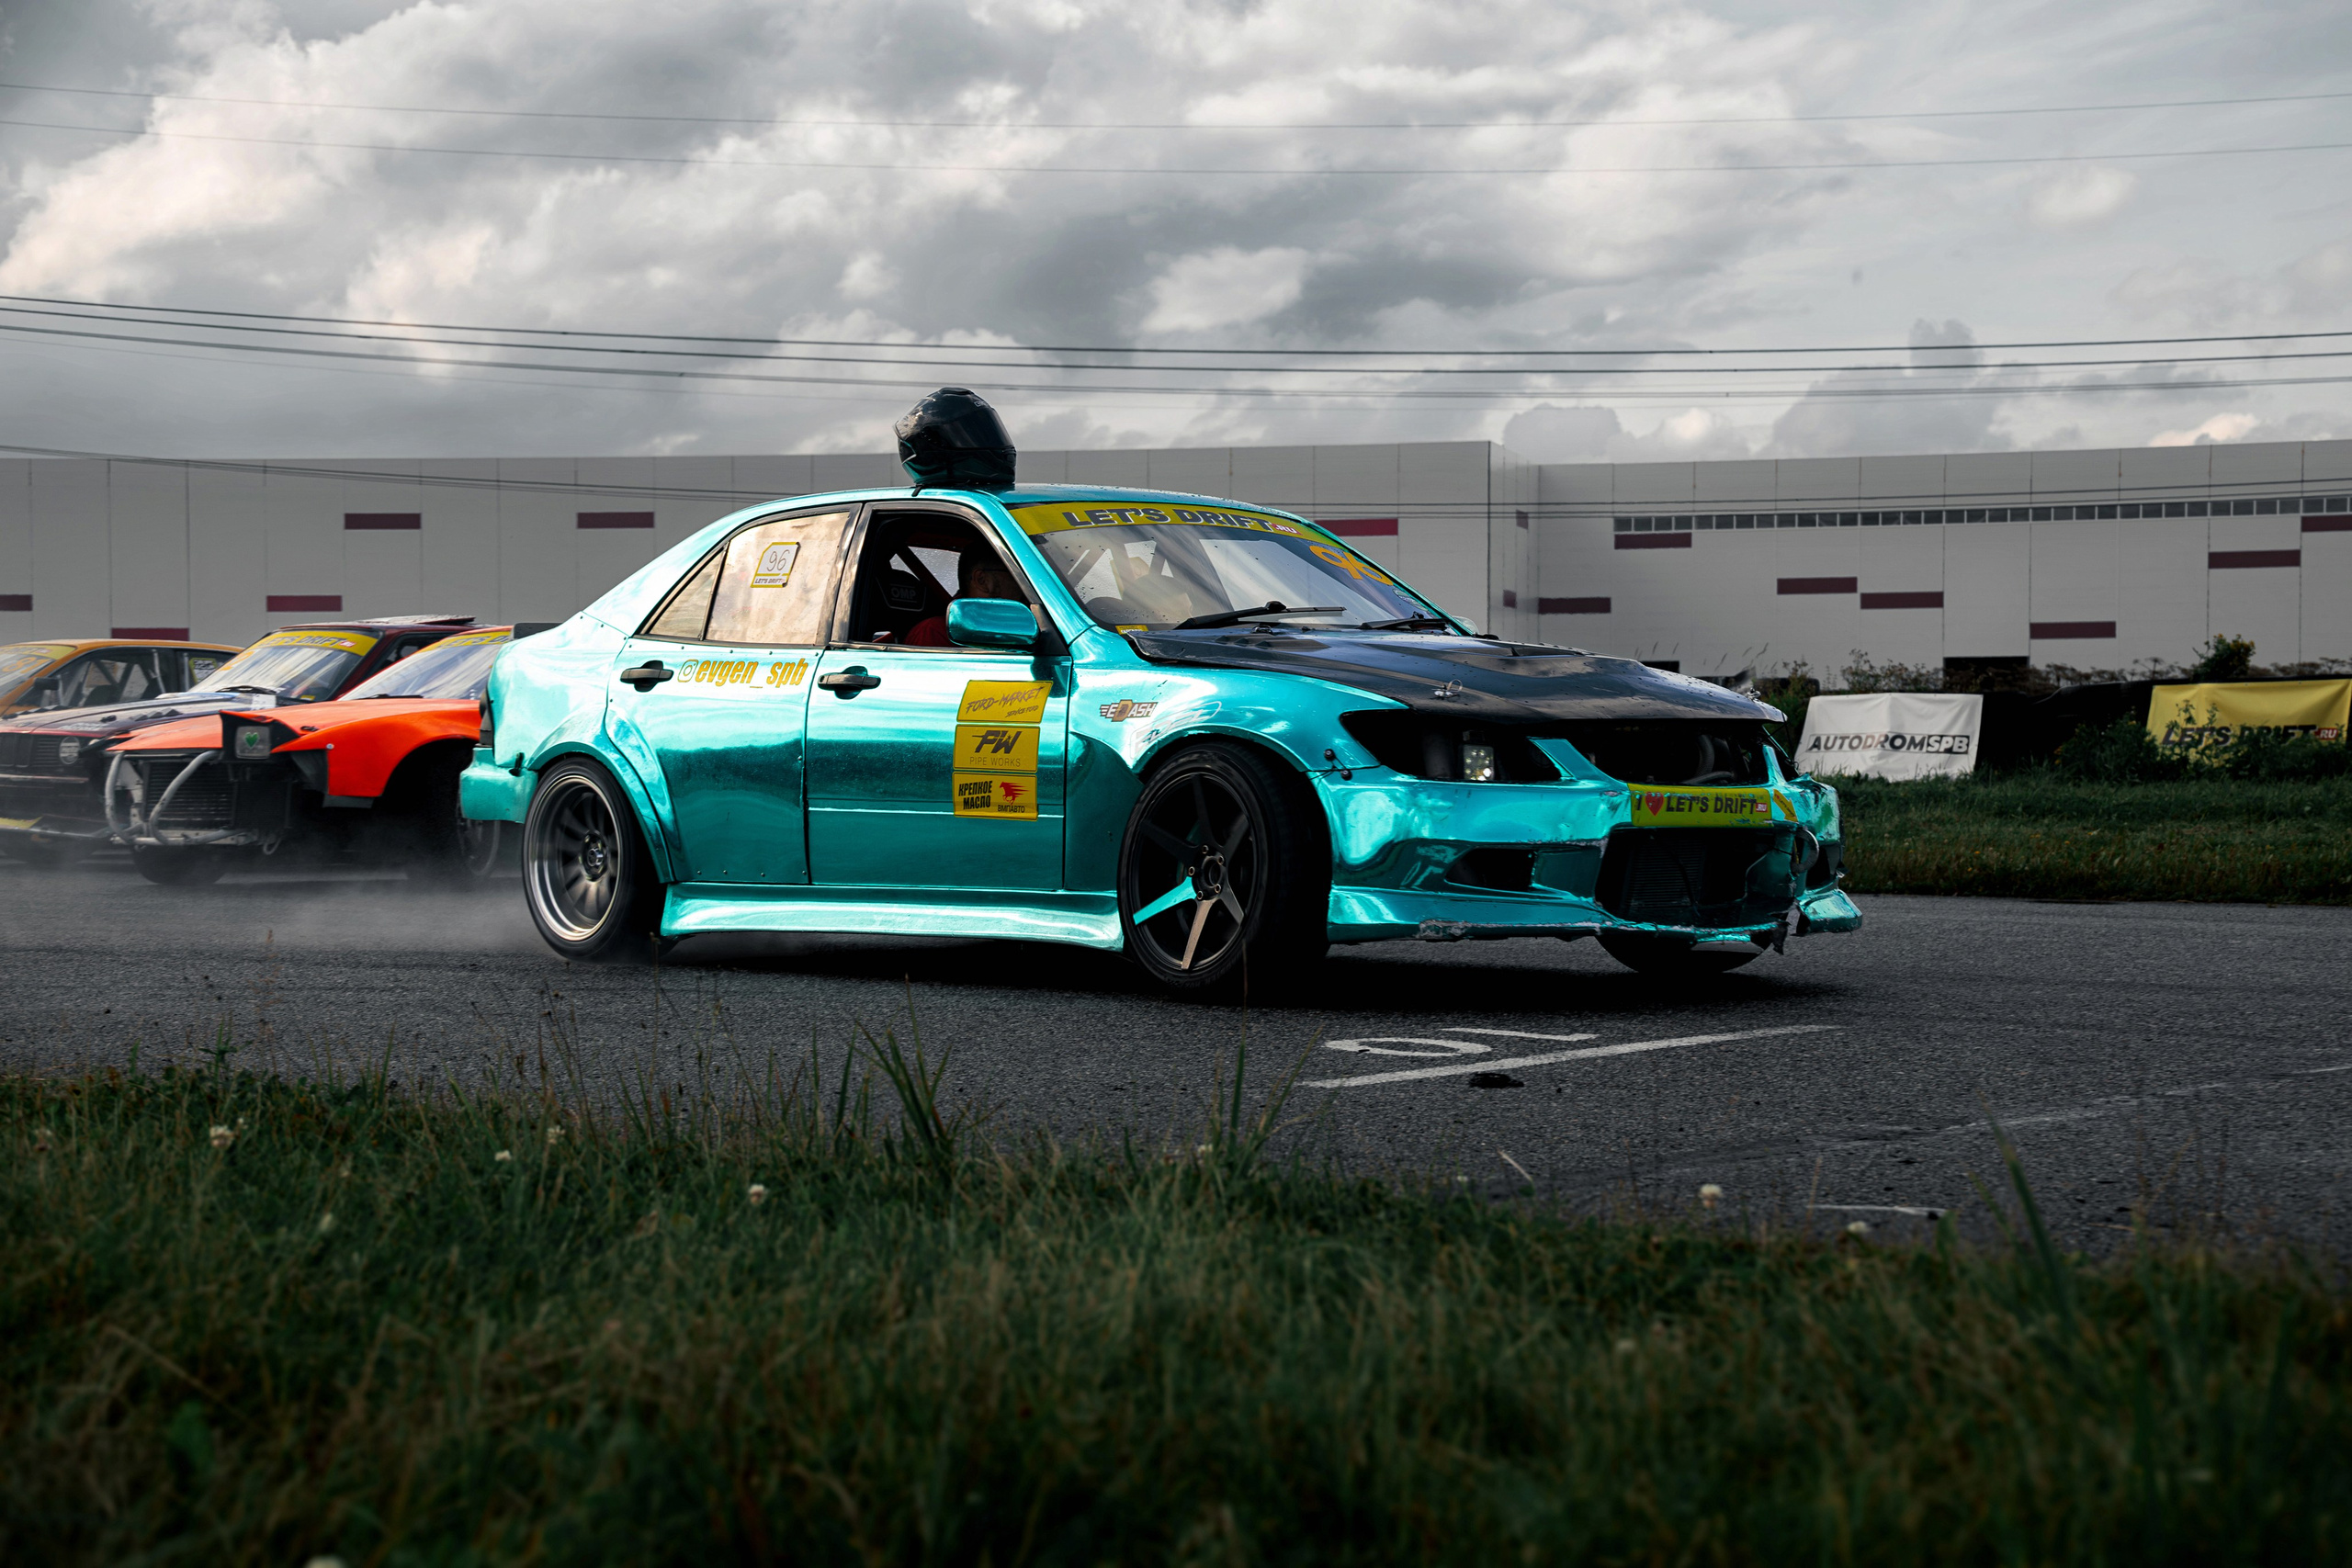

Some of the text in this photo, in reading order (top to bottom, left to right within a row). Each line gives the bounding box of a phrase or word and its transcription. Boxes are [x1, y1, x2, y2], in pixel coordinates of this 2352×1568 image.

[1062, 507, 1170, 527] LET'S
[766, 549, 790, 571] 96
[1309, 545, 1395, 586] 96
[891, 587, 917, 600] OMP
[969, 757, 1021, 768] PIPE WORKS
[958, 780, 993, 797] КРЕПКОЕ
[963, 795, 991, 810] МАСЛО
[1665, 795, 1710, 814] LET'S
